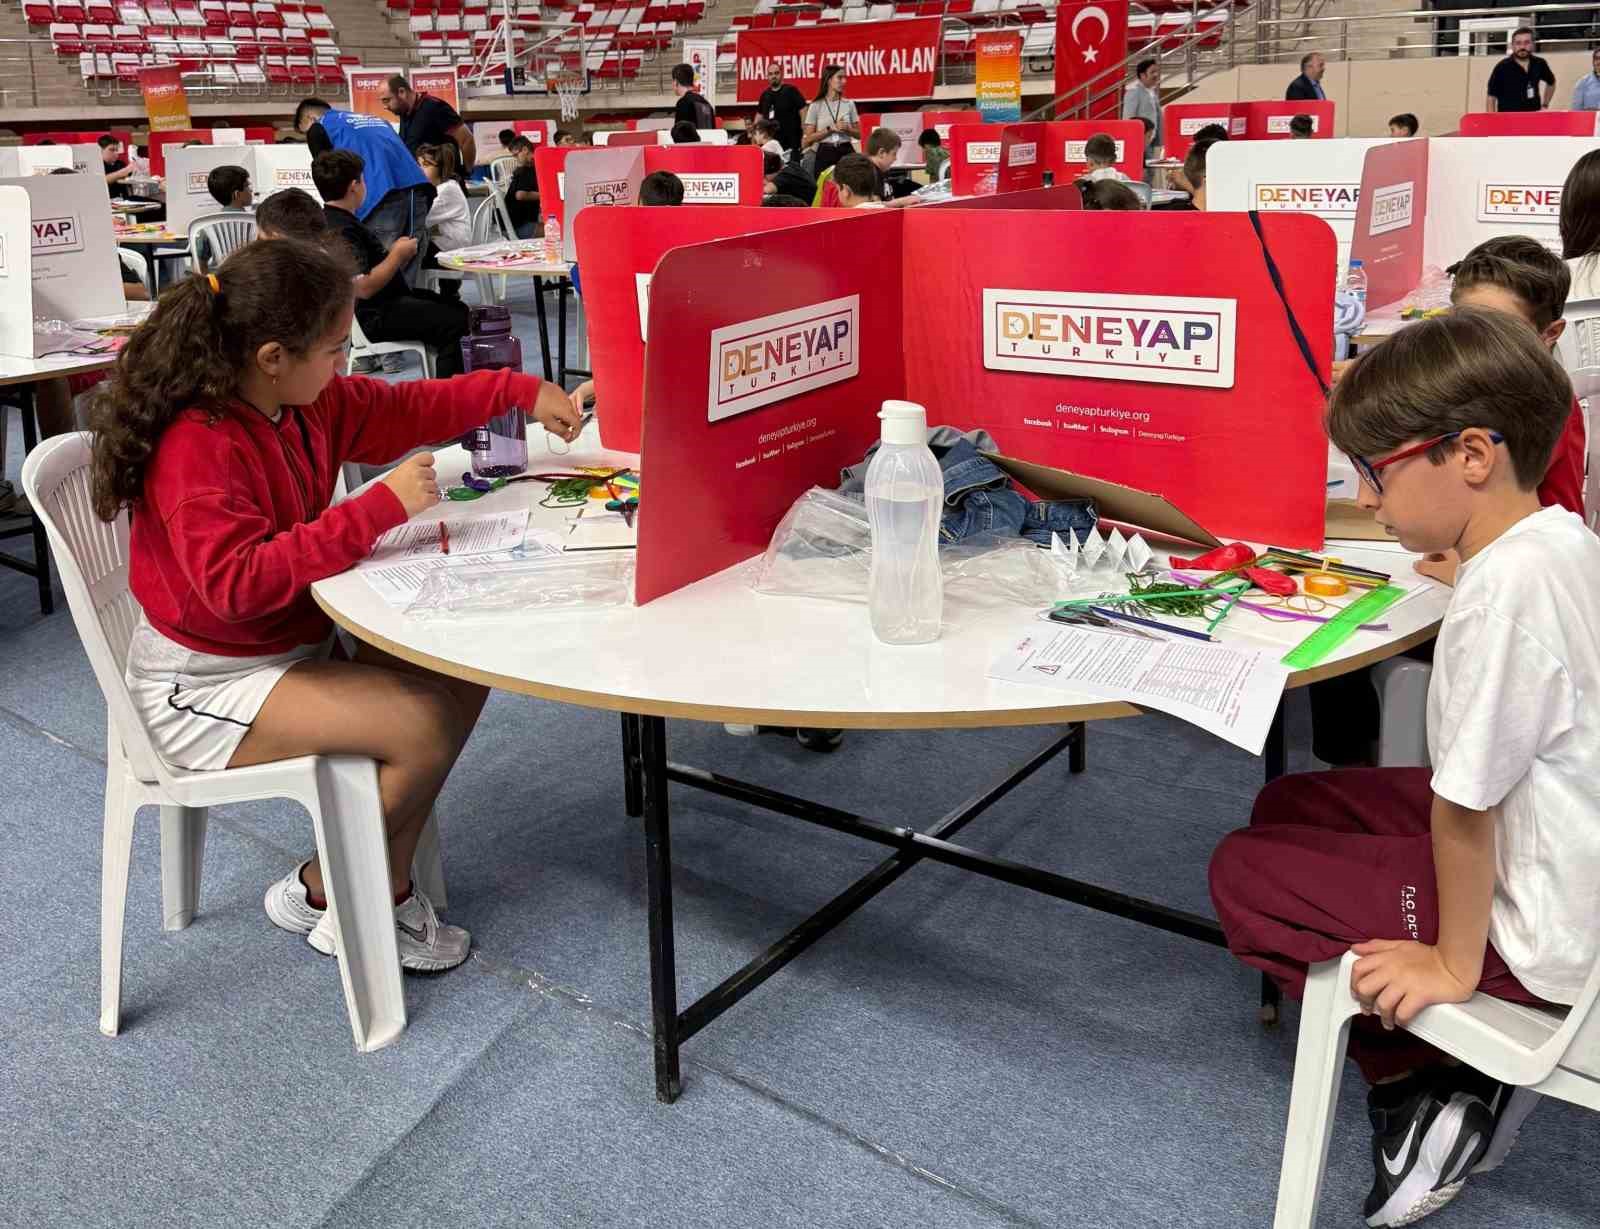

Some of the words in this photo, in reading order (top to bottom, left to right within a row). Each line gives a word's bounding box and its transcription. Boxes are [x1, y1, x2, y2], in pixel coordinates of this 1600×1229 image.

[888, 46, 935, 74] ALAN
[685, 181, 733, 192] ENEYAP
[1490, 190, 1560, 205] DENE
[1002, 311, 1213, 351] DENEYAP
[724, 320, 849, 382] DENEYAP
